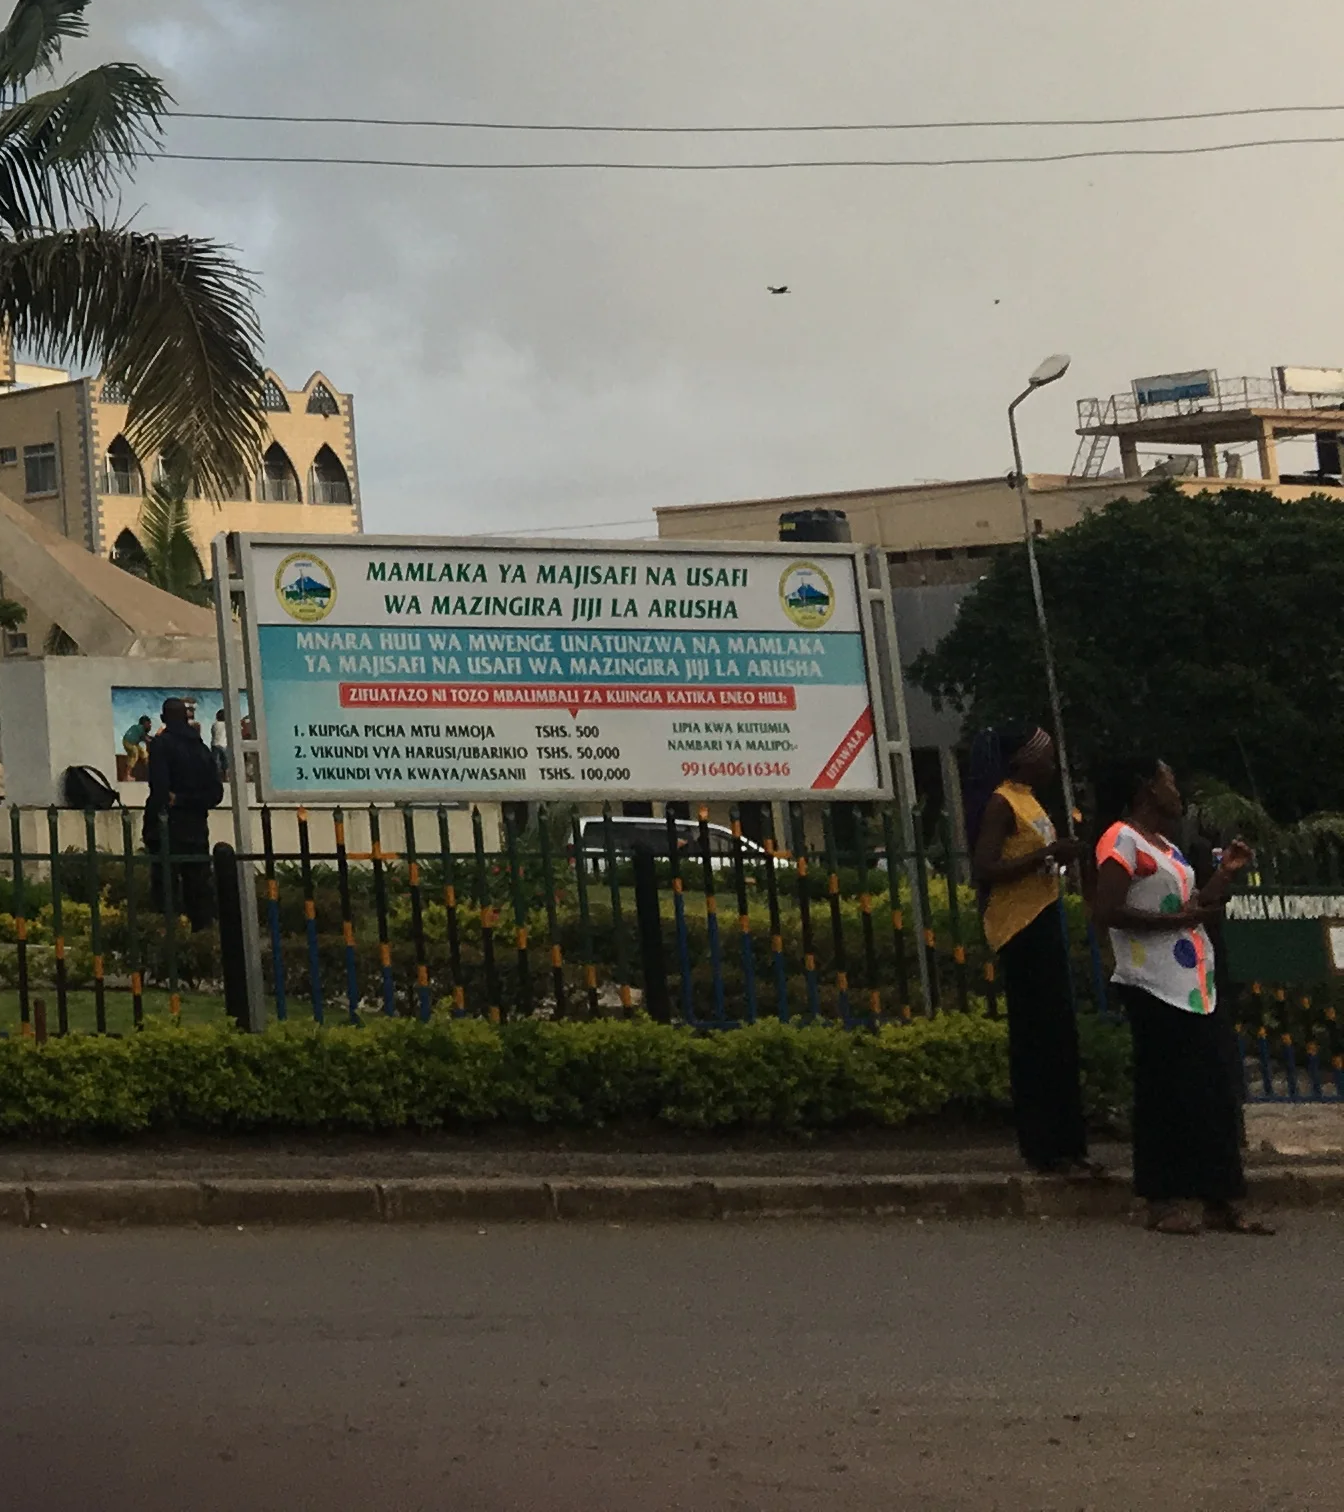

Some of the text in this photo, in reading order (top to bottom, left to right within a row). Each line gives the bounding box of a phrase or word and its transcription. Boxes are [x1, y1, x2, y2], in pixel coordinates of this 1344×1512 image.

[366, 561, 748, 589] MAMLAKA YA MAJISAFI NA USAFI
[384, 594, 739, 622] WA MAZINGIRA JIJI LA ARUSHA
[296, 631, 825, 655] MNARA HUU WA MWENGE UNATUNZWA NA MAMLAKA
[304, 655, 824, 681] YA MAJISAFI NA USAFI WA MAZINGIRA JIJI LA ARUSHA
[349, 688, 428, 702] ZIFUATAZO
[432, 689, 447, 703] NI
[451, 689, 489, 703] TOZO
[493, 689, 579, 704] MBALIMBALI
[583, 690, 603, 704] ZA
[608, 690, 663, 705] KUINGIA
[667, 691, 715, 705] KATIKA
[720, 691, 754, 705] ENEO
[294, 725, 599, 740] 1. KUPIGA PICHA MTU MMOJA TSHS. 500
[672, 722, 791, 734] LIPIA KWA KUTUMIA
[294, 746, 620, 762] 2. VIKUNDI VYA HARUSI/UBARIKIO TSHS. 50,000
[667, 740, 722, 752] NAMBARI
[725, 740, 742, 752] YA
[296, 767, 631, 783] 3. VIKUNDI VYA KWAYA/WASANII TSHS. 100,000
